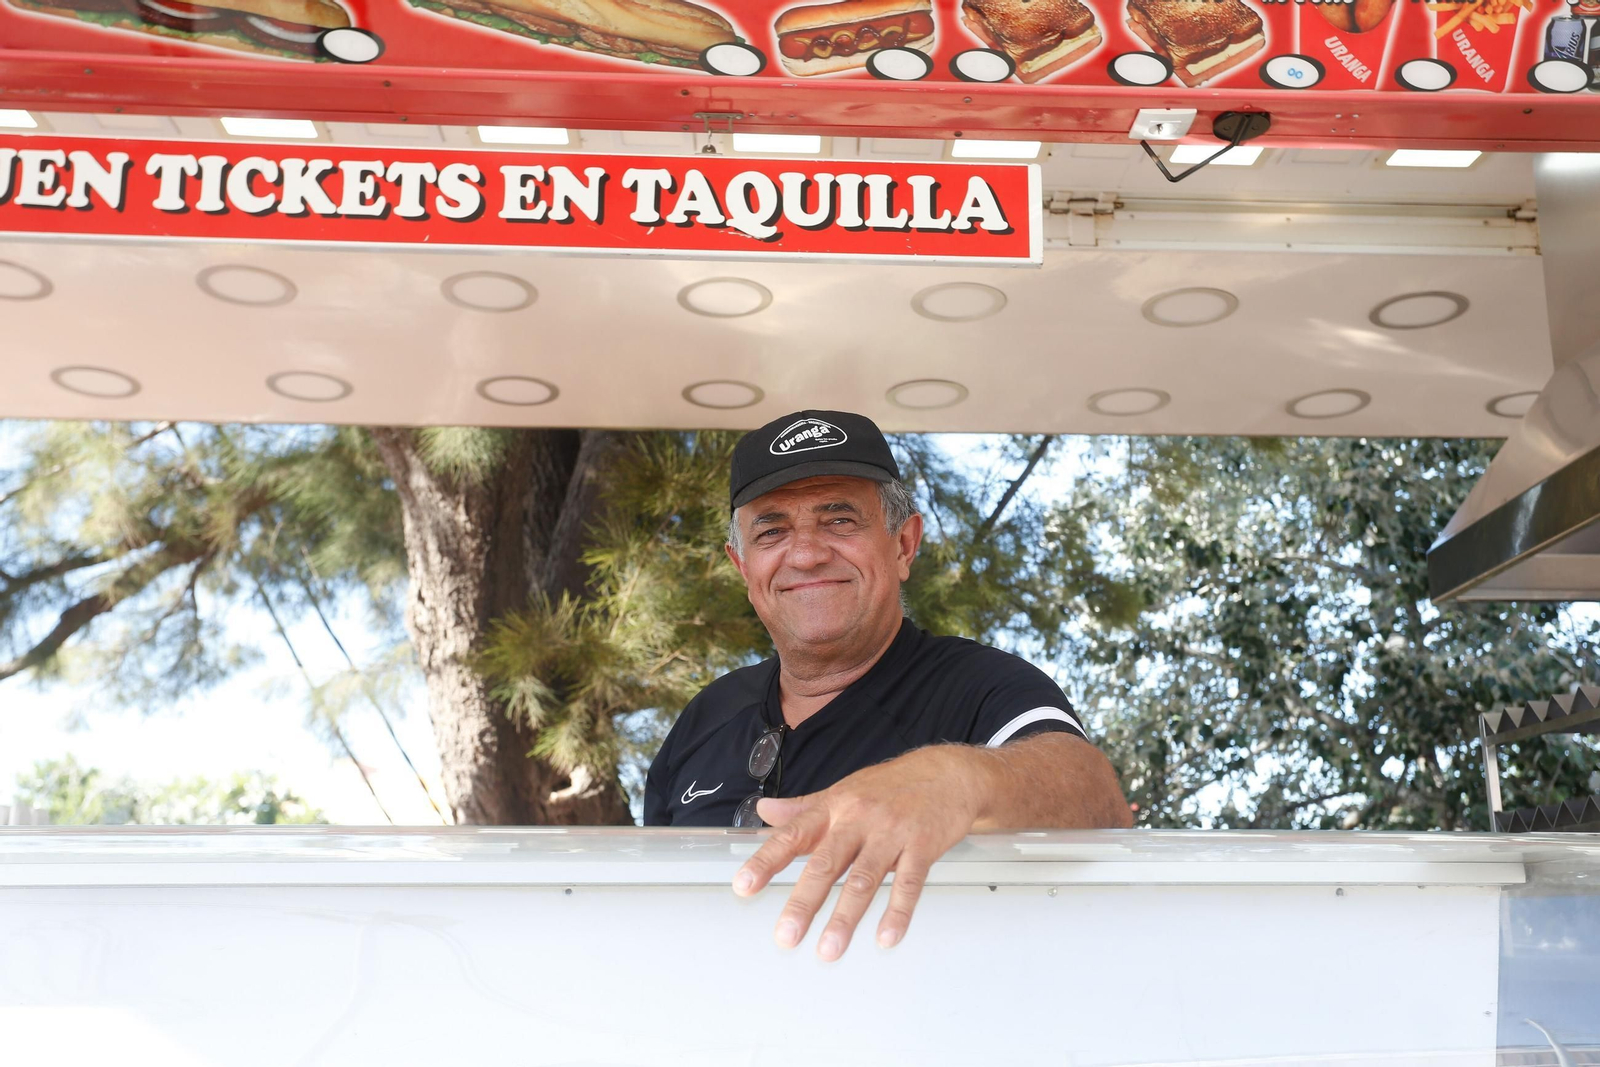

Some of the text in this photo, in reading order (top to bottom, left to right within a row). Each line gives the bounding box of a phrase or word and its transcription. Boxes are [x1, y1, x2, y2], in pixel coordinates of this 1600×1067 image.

[1324, 36, 1373, 83] URANGA
[1452, 28, 1496, 83] URANGA
[146, 154, 483, 221] TICKETS
[499, 166, 607, 223] EN
[622, 168, 1011, 241] TAQUILLA
[779, 425, 831, 452] Uranga
